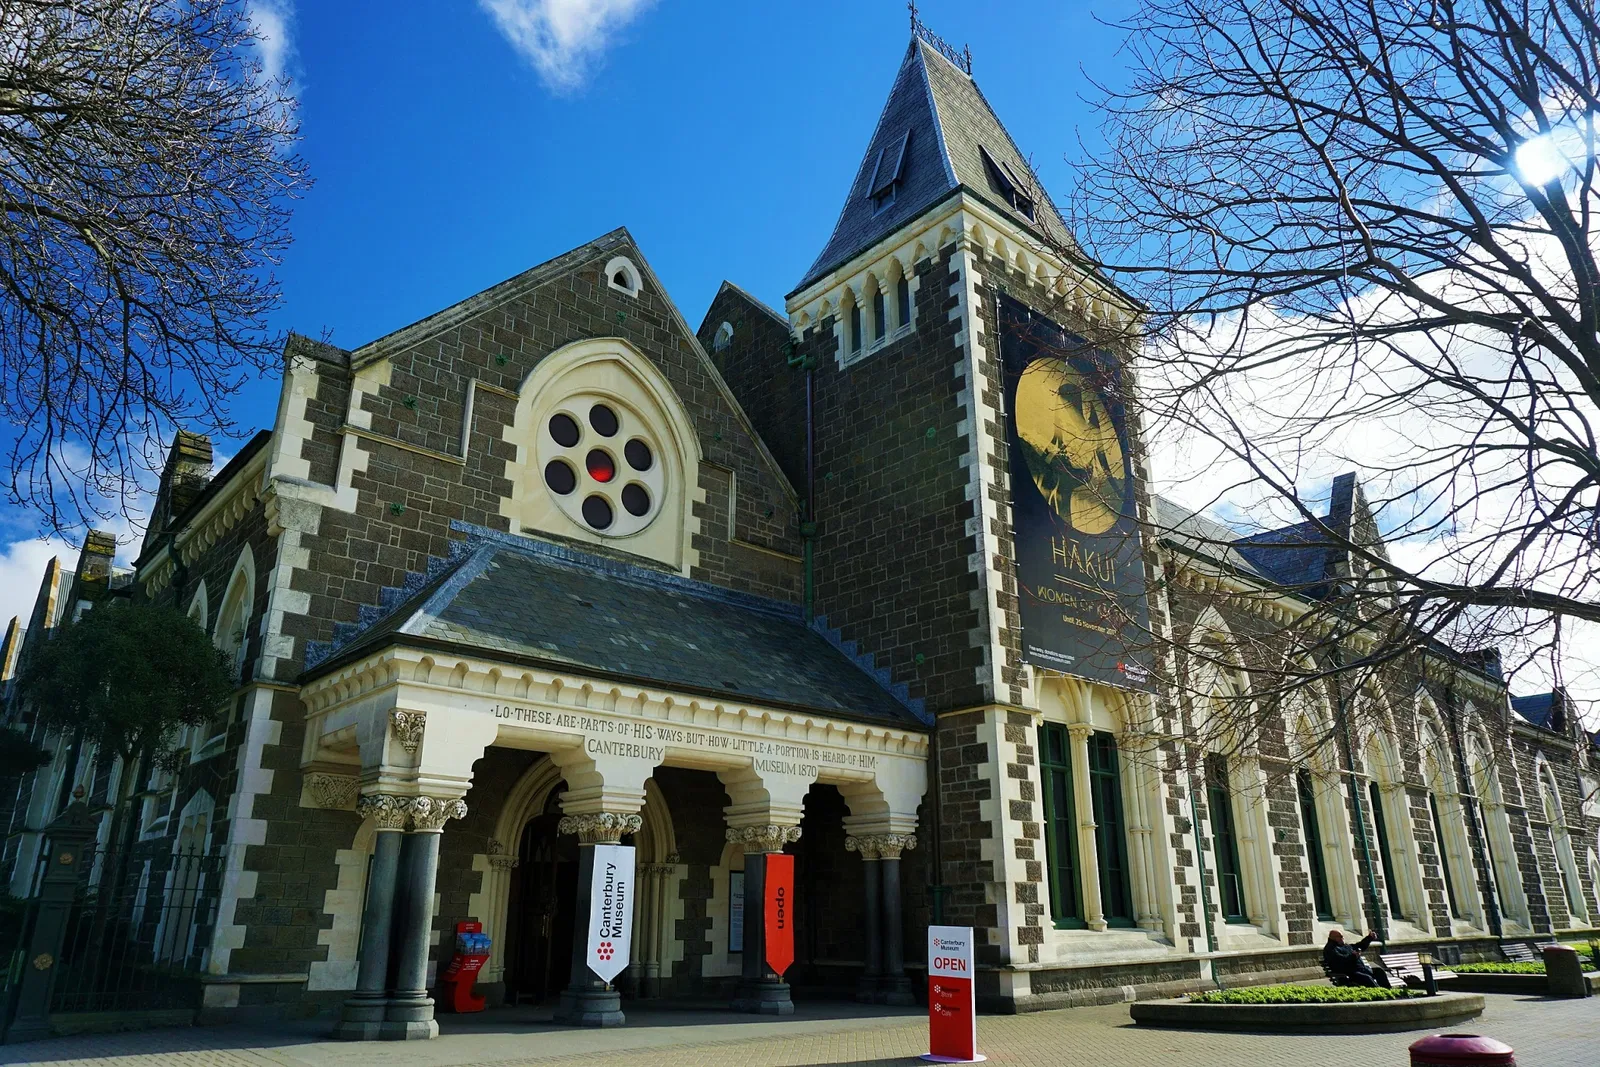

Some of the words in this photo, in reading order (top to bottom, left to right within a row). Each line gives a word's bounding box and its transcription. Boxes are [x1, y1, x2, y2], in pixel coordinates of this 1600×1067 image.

[1037, 585, 1077, 608] WOMEN
[495, 705, 510, 719] LO
[515, 707, 552, 725] THESE
[556, 713, 577, 728] ARE
[580, 717, 614, 733] PARTS
[618, 722, 630, 735] OF
[633, 723, 653, 739] HIS
[657, 728, 683, 742] WAYS
[686, 732, 705, 746] BUT
[708, 735, 729, 749] HOW
[733, 739, 764, 754] LITTLE
[767, 743, 773, 754] A
[775, 744, 810, 760] PORTION
[812, 749, 820, 761] IS
[822, 751, 846, 764] HEARD
[849, 754, 857, 766] OF
[859, 755, 876, 769] HIM
[588, 738, 664, 761] CANTERBURY
[755, 758, 796, 776] MUSEUM
[798, 764, 817, 778] 1870
[599, 862, 617, 938] Canterbury
[612, 881, 625, 938] Museum
[775, 886, 785, 930] open
[940, 939, 965, 947] Canterbury
[934, 957, 966, 972] OPEN
